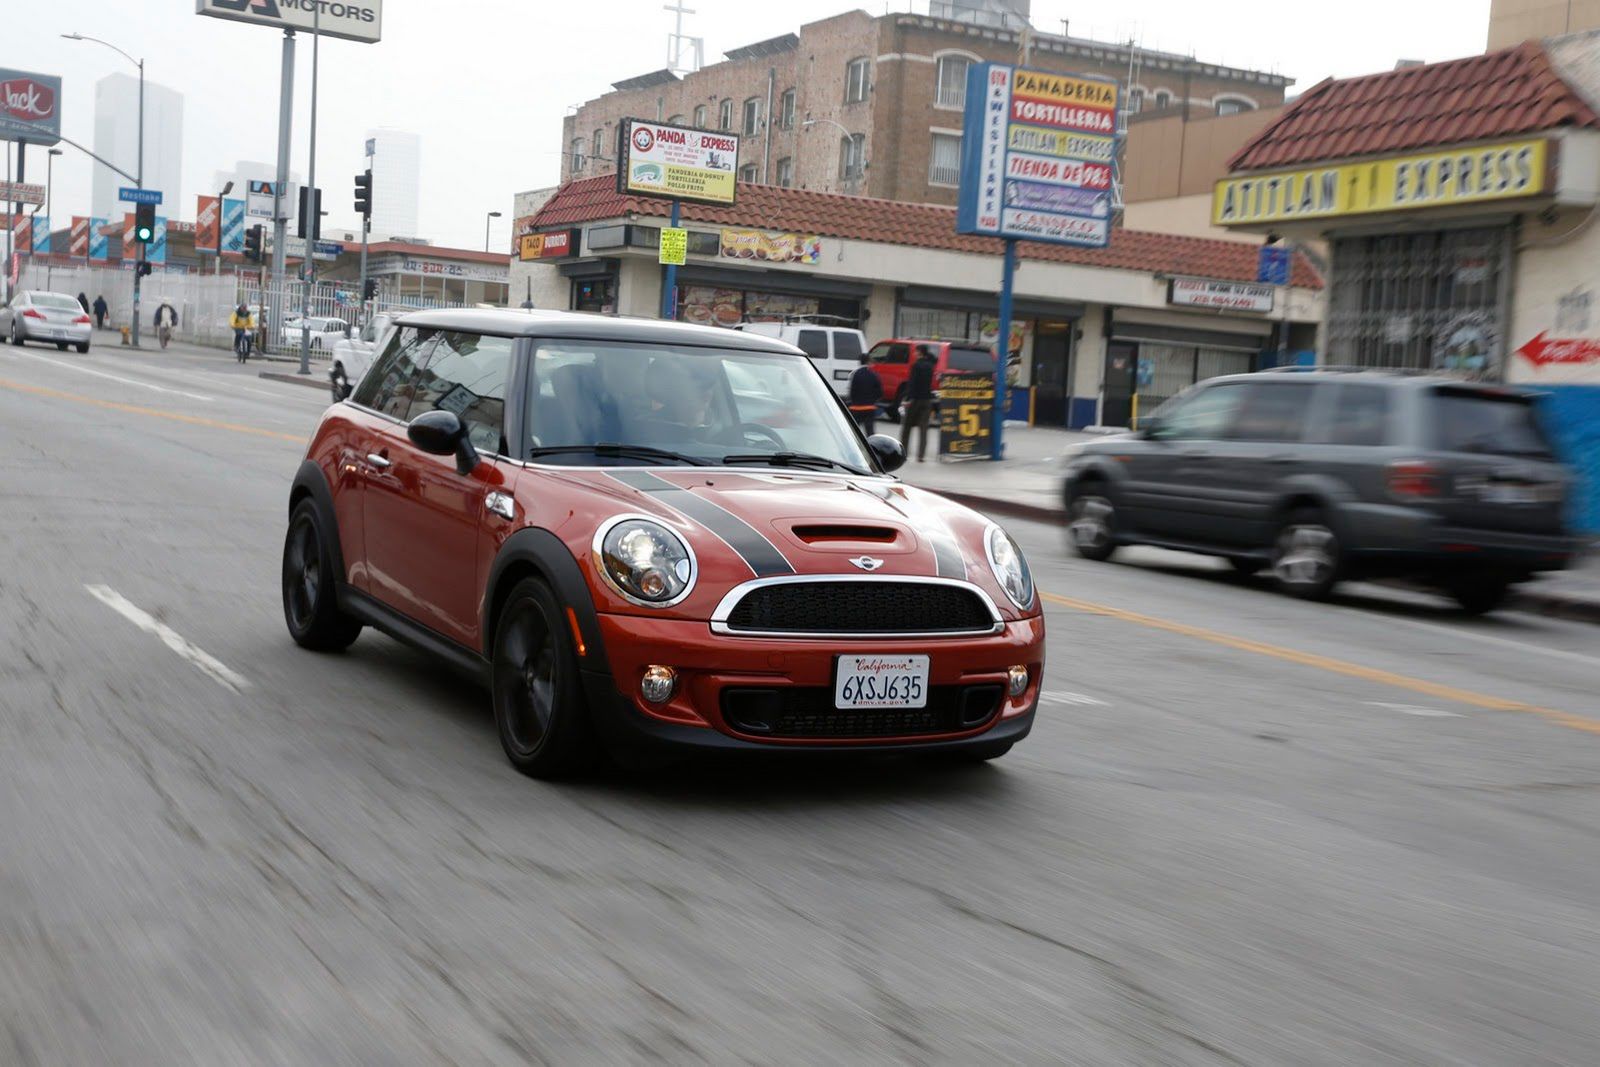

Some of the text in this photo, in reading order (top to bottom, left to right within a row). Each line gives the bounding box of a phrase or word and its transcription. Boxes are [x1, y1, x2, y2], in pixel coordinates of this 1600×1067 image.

[0, 83, 52, 115] Jack
[1016, 73, 1114, 104] PANADERIA
[1014, 100, 1113, 130] TORTILLERIA
[656, 128, 735, 153] PANDA EXPRESS
[1011, 157, 1057, 180] TIENDA
[1063, 164, 1083, 182] DE
[121, 191, 161, 201] Westlake
[667, 182, 686, 190] POLLO
[1221, 146, 1534, 221] ATITLAN EXPRESS
[526, 237, 540, 249] TACO
[856, 658, 912, 674] California
[842, 675, 922, 701] 6XSJ635
